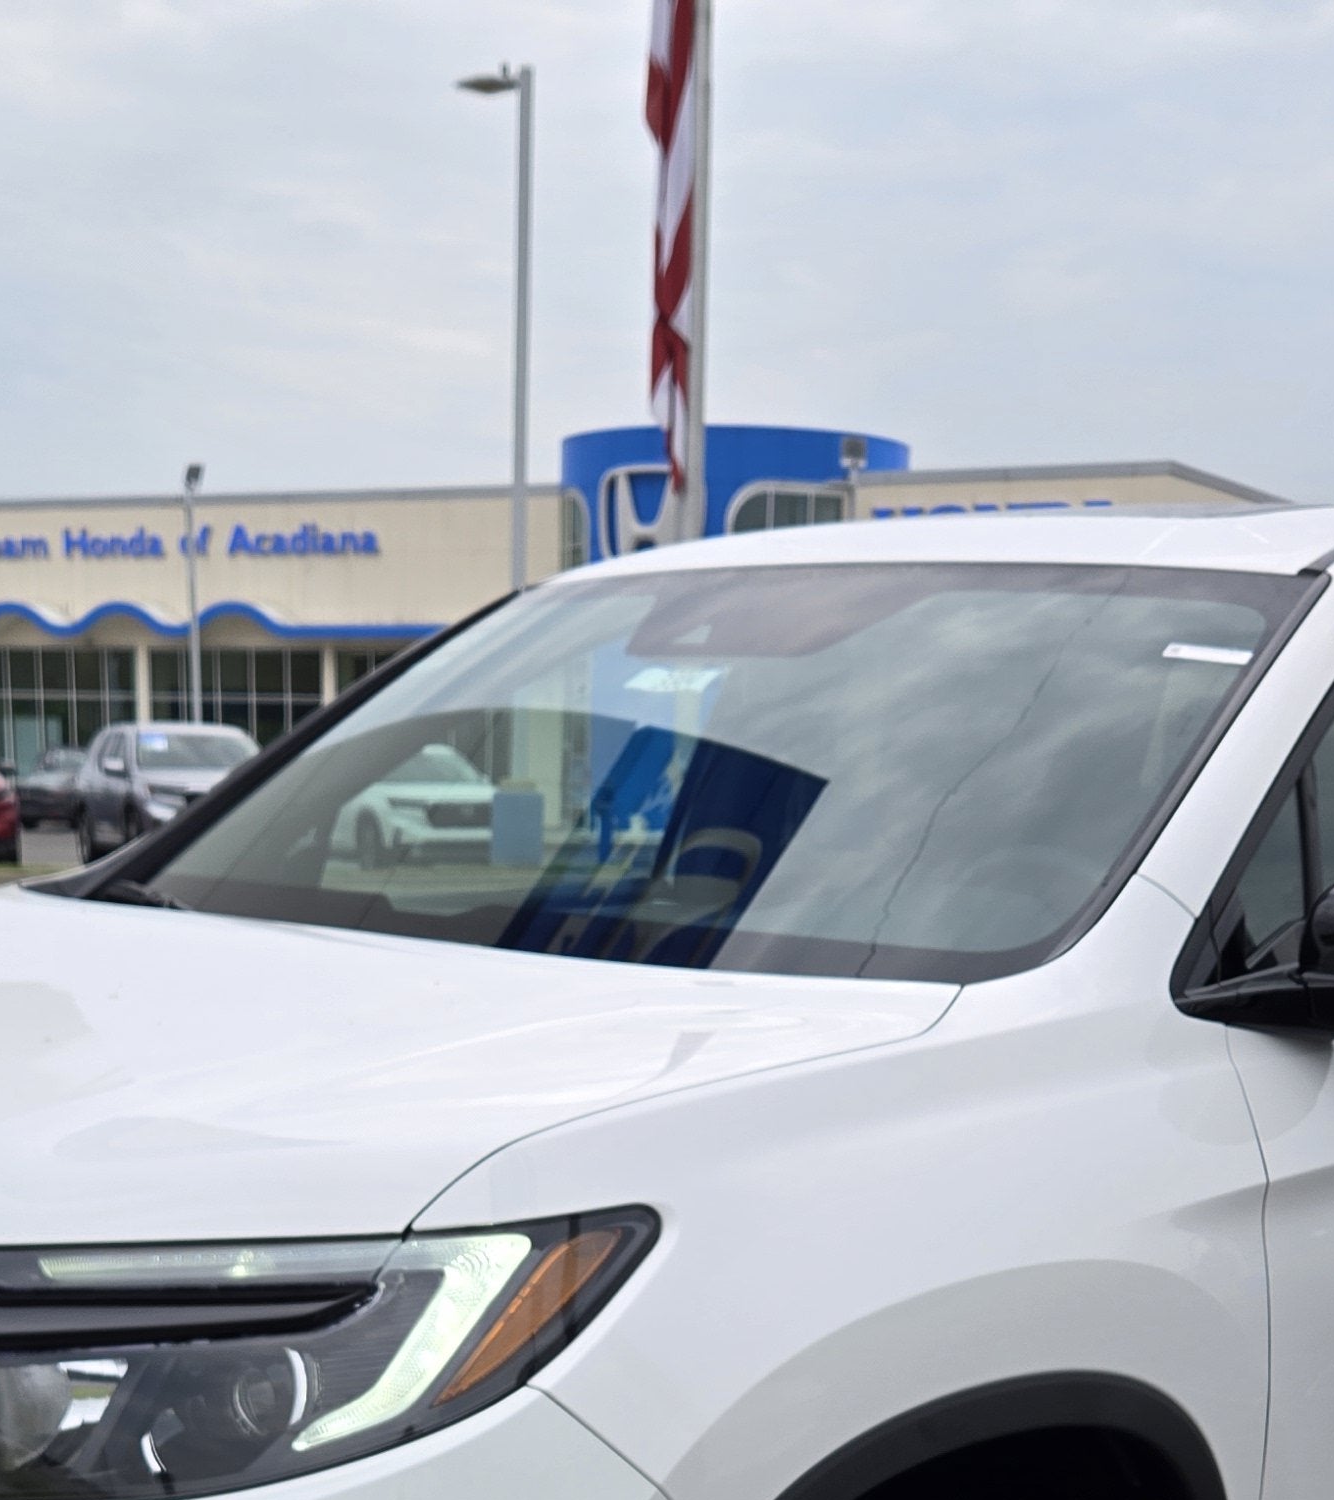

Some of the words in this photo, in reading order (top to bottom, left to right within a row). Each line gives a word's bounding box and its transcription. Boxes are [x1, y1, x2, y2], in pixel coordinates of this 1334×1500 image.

[63, 525, 164, 560] Honda
[179, 524, 212, 556] of
[229, 524, 379, 557] Acadiana
